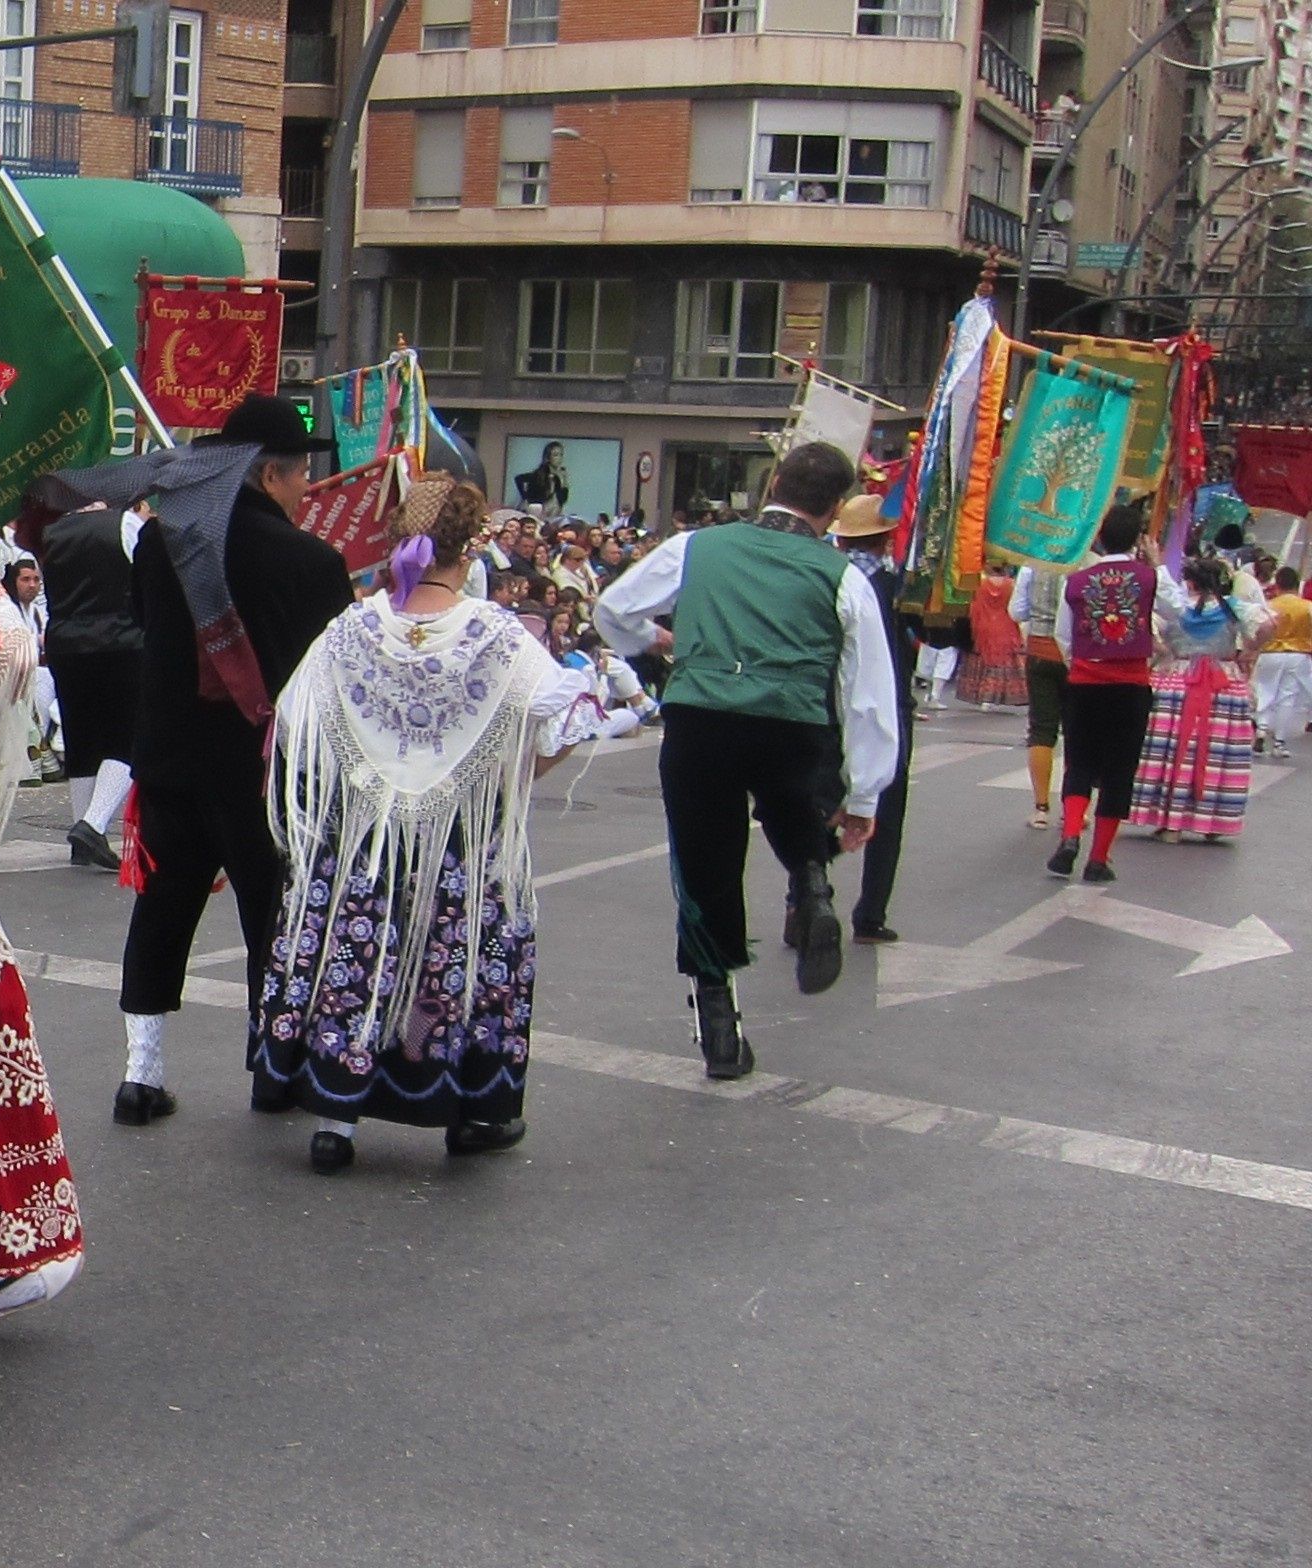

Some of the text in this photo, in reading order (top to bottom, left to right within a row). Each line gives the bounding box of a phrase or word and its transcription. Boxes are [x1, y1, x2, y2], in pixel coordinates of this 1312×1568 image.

[153, 296, 268, 324] Grupo de Danzas
[187, 343, 202, 357] de
[218, 361, 230, 376] la
[299, 501, 322, 533] RUPO
